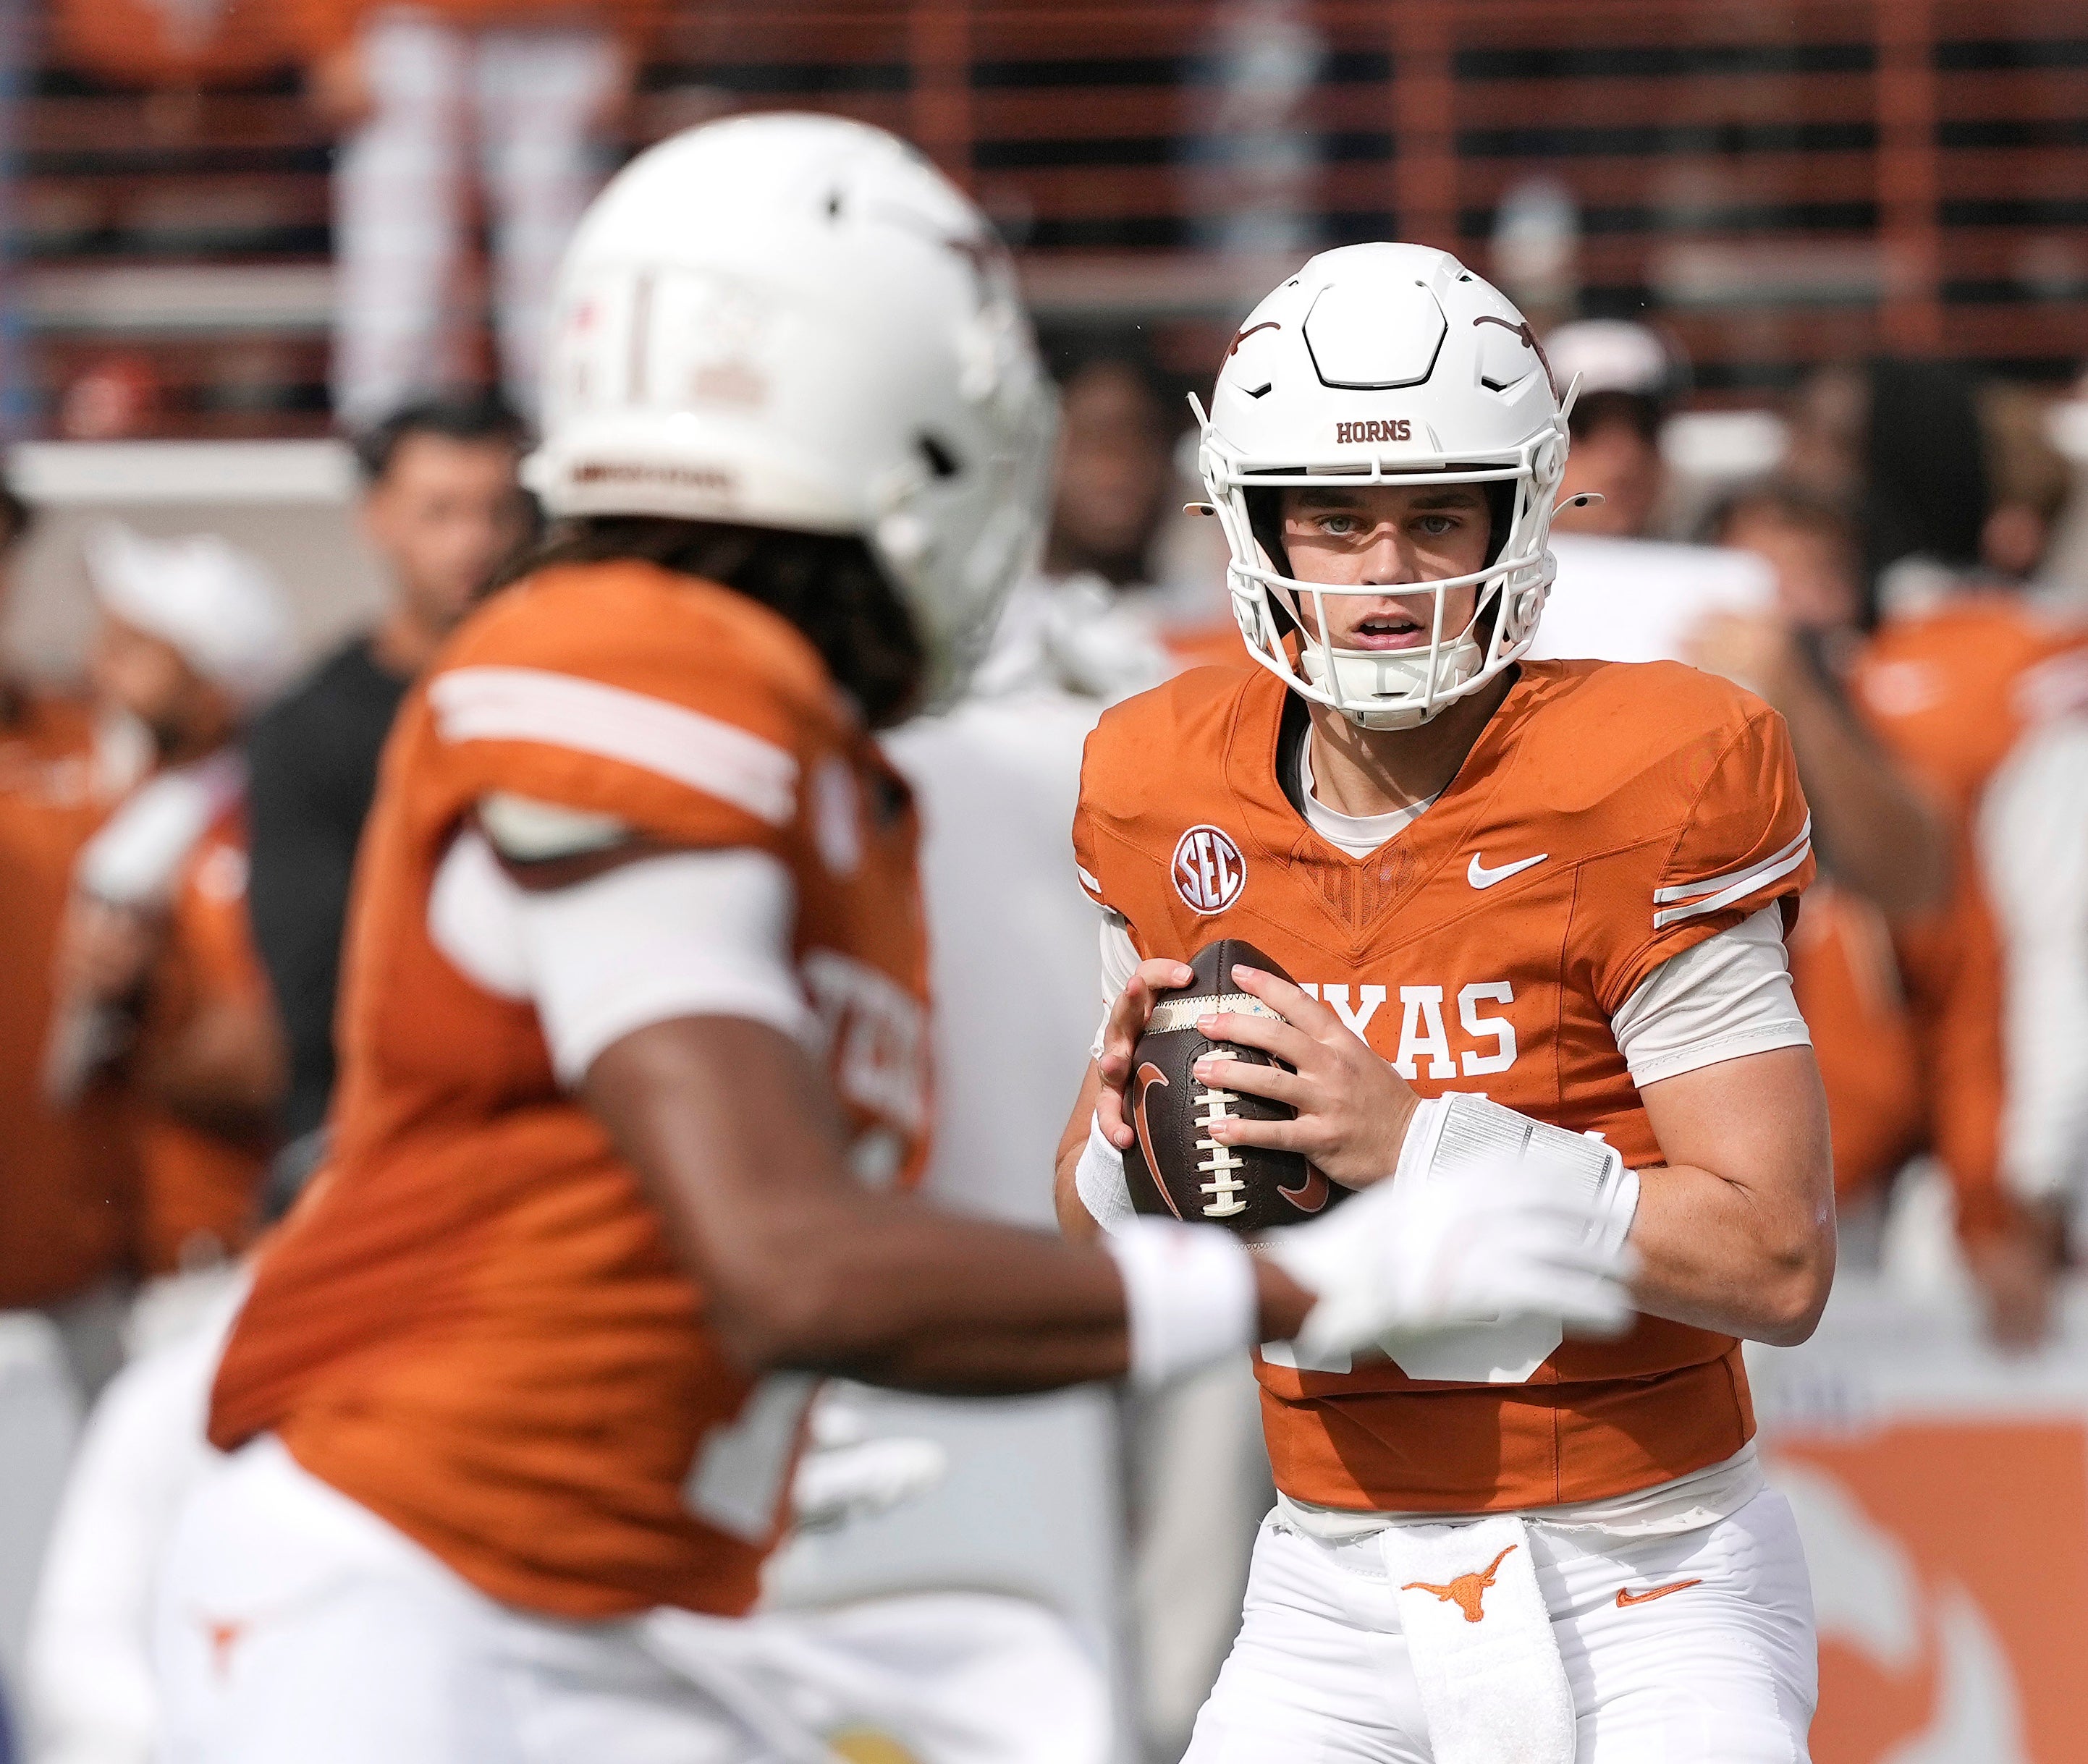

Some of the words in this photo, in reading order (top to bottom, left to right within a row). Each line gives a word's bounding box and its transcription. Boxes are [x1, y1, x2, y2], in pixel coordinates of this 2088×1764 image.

[1337, 420, 1411, 444] HORNS
[1178, 831, 1240, 908] SEC
[1298, 980, 1518, 1080] XAS
